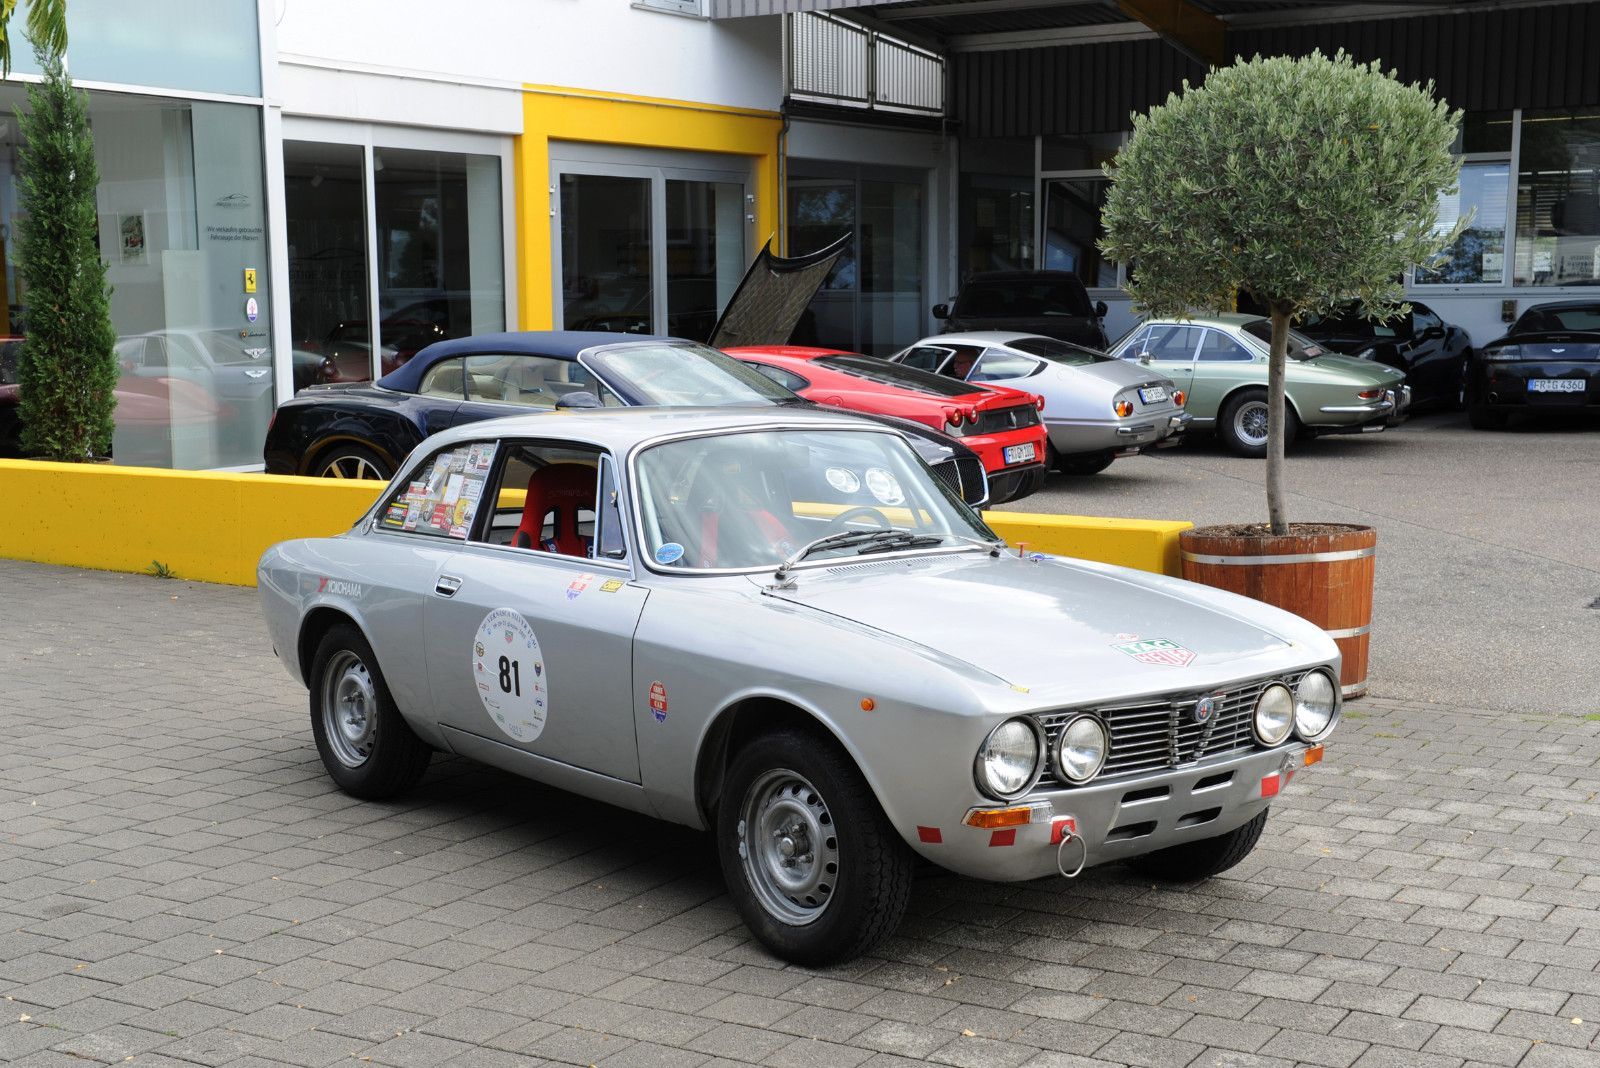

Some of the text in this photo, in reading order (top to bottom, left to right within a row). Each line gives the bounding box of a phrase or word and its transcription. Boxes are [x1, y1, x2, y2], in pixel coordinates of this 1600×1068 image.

[1560, 380, 1584, 390] 4360
[327, 579, 362, 598] YOKOHAMA
[1120, 639, 1177, 654] TAG
[1133, 649, 1194, 667] HEUER
[498, 655, 521, 697] 81
